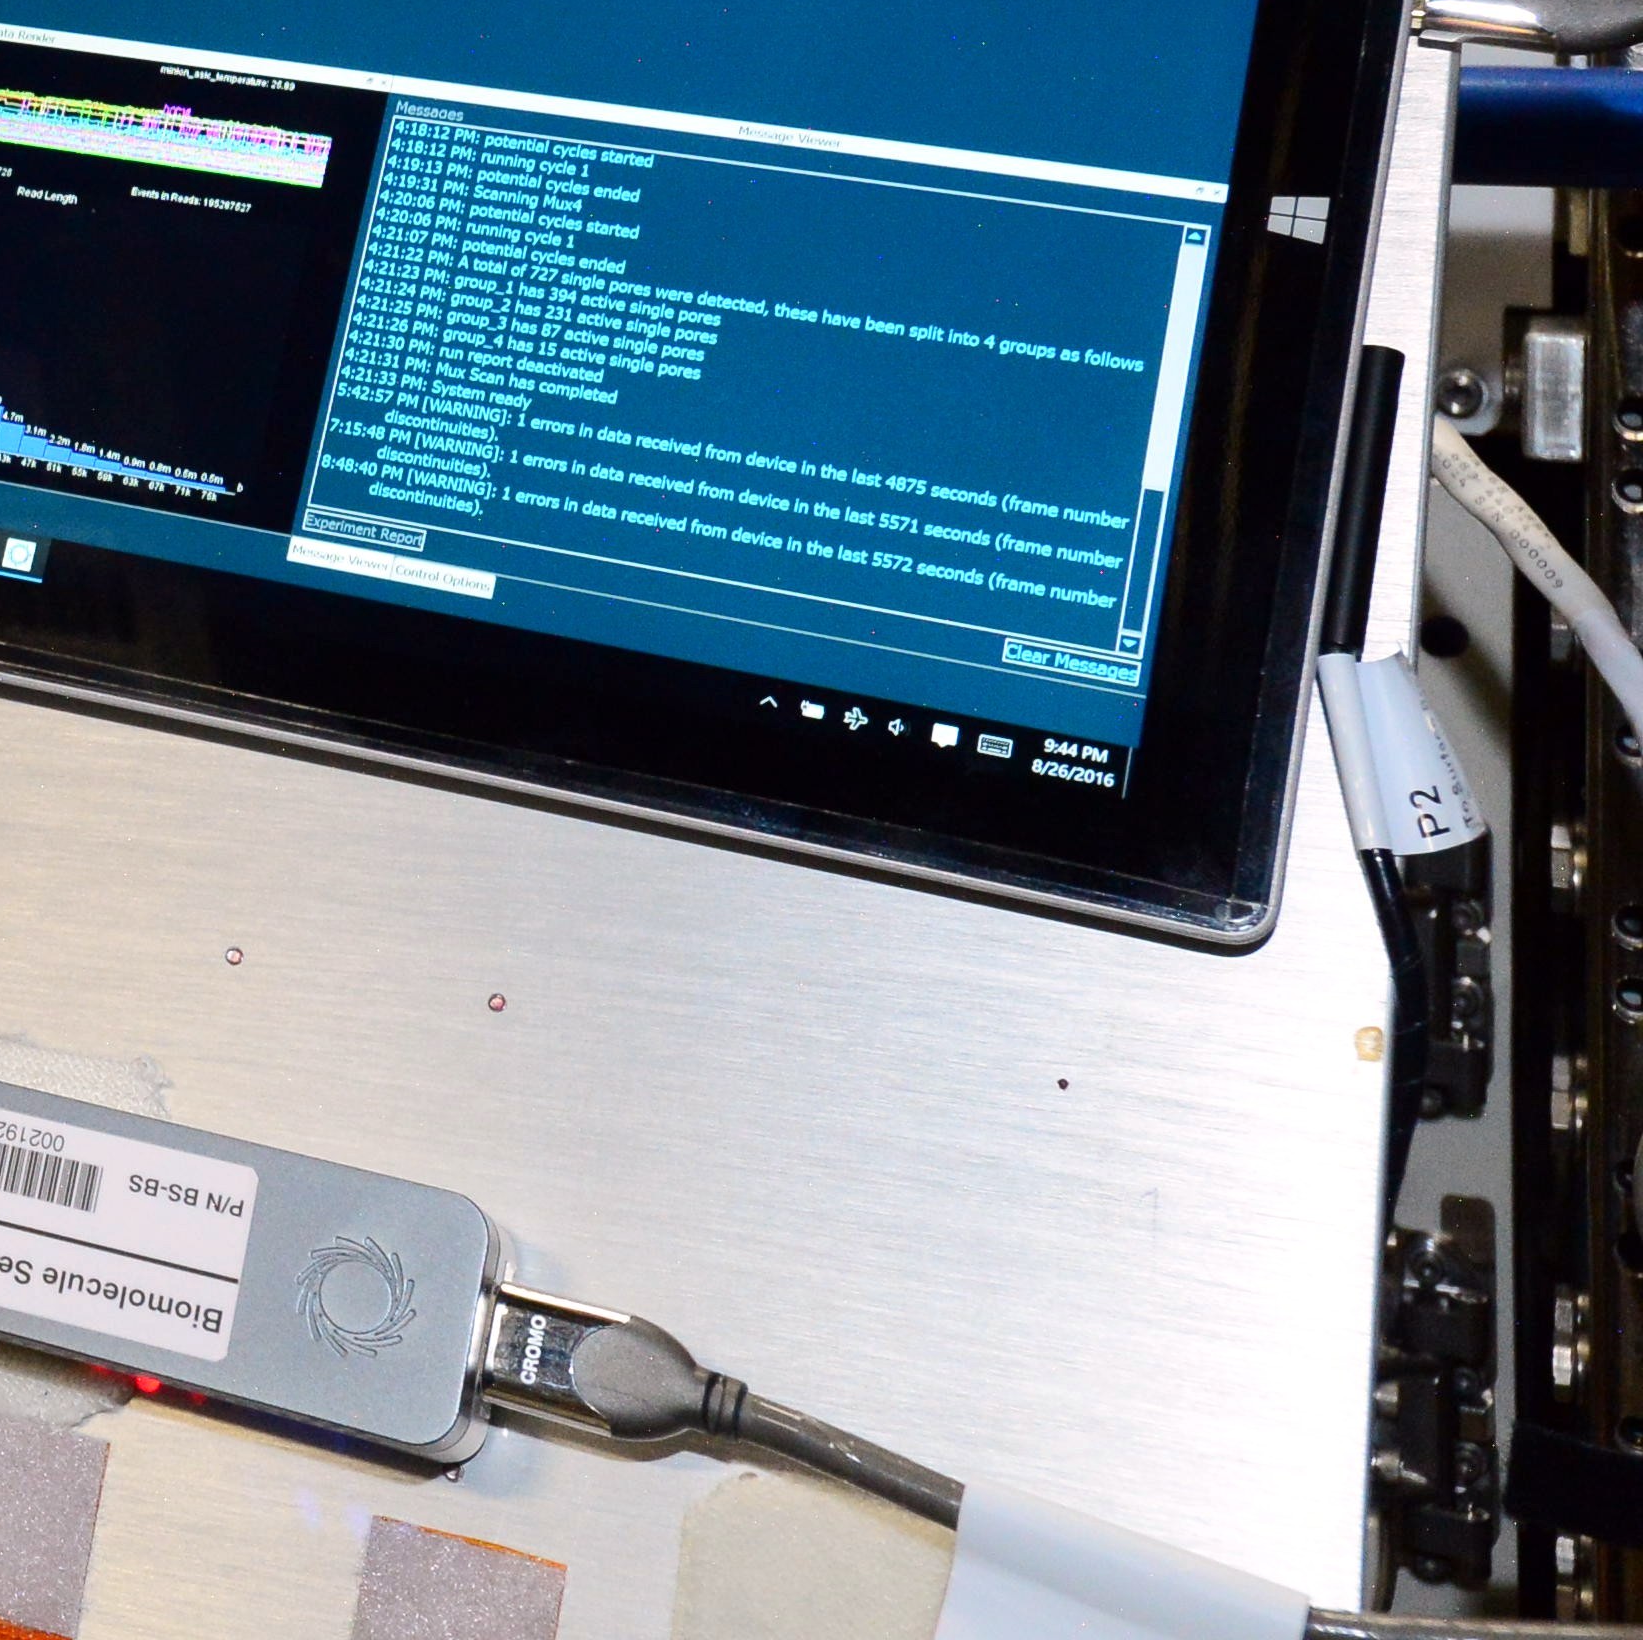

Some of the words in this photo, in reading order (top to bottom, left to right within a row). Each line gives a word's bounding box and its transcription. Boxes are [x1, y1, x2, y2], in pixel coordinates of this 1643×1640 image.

[394, 120, 451, 141] 4:18:12
[453, 128, 481, 148] PM:
[483, 134, 551, 155] potential
[552, 144, 598, 162] cycles
[600, 149, 655, 169] started
[383, 171, 438, 194] 4:19:31
[442, 179, 470, 197] PM:
[473, 184, 540, 211] Scanning
[542, 193, 583, 214] Mux4
[368, 241, 425, 263] 4:21:22
[427, 249, 455, 268] PM:
[457, 254, 469, 271] A
[473, 257, 508, 276] total
[510, 263, 529, 278] of
[530, 265, 560, 283] 727
[560, 271, 606, 292] single
[608, 280, 652, 298] pores
[655, 287, 694, 305] were
[696, 291, 770, 318] detected,
[774, 303, 819, 324] these
[821, 309, 862, 330] have
[864, 315, 906, 337] been
[908, 325, 946, 343] split
[947, 328, 981, 348] into
[983, 334, 996, 350] 4
[999, 339, 1057, 361] groups
[1059, 348, 1081, 364] as
[1084, 349, 1145, 374] follows
[384, 408, 499, 444] discontinuities).
[337, 381, 395, 405] 5:42:57
[396, 391, 420, 410] PM
[421, 396, 513, 428] [WARNING]:
[517, 412, 526, 428] 1
[530, 417, 576, 437] errors
[578, 422, 594, 440] in
[596, 426, 633, 446] data
[635, 435, 703, 462] received
[704, 443, 743, 465] from
[745, 450, 798, 474] device
[800, 460, 817, 478] in
[820, 463, 849, 483] the
[851, 467, 883, 489] last
[885, 475, 928, 496] 4875
[930, 485, 998, 509] seconds
[1001, 493, 1060, 519] (frame
[1062, 507, 1131, 530] number
[304, 514, 377, 540] Experiment
[379, 528, 424, 550] Report
[1510, 530, 1563, 589] 000009
[1005, 642, 1051, 666] Clear
[1053, 652, 1139, 683] Messages
[1044, 738, 1079, 759] 9:44
[1081, 745, 1110, 765] PM
[1031, 758, 1115, 789] 8/26/2016
[1409, 785, 1451, 838] P2
[128, 1173, 201, 1208] BS-BS
[205, 1195, 245, 1218] P/N
[42, 1265, 224, 1334] Biomolecule
[519, 1314, 547, 1385] CROMO
